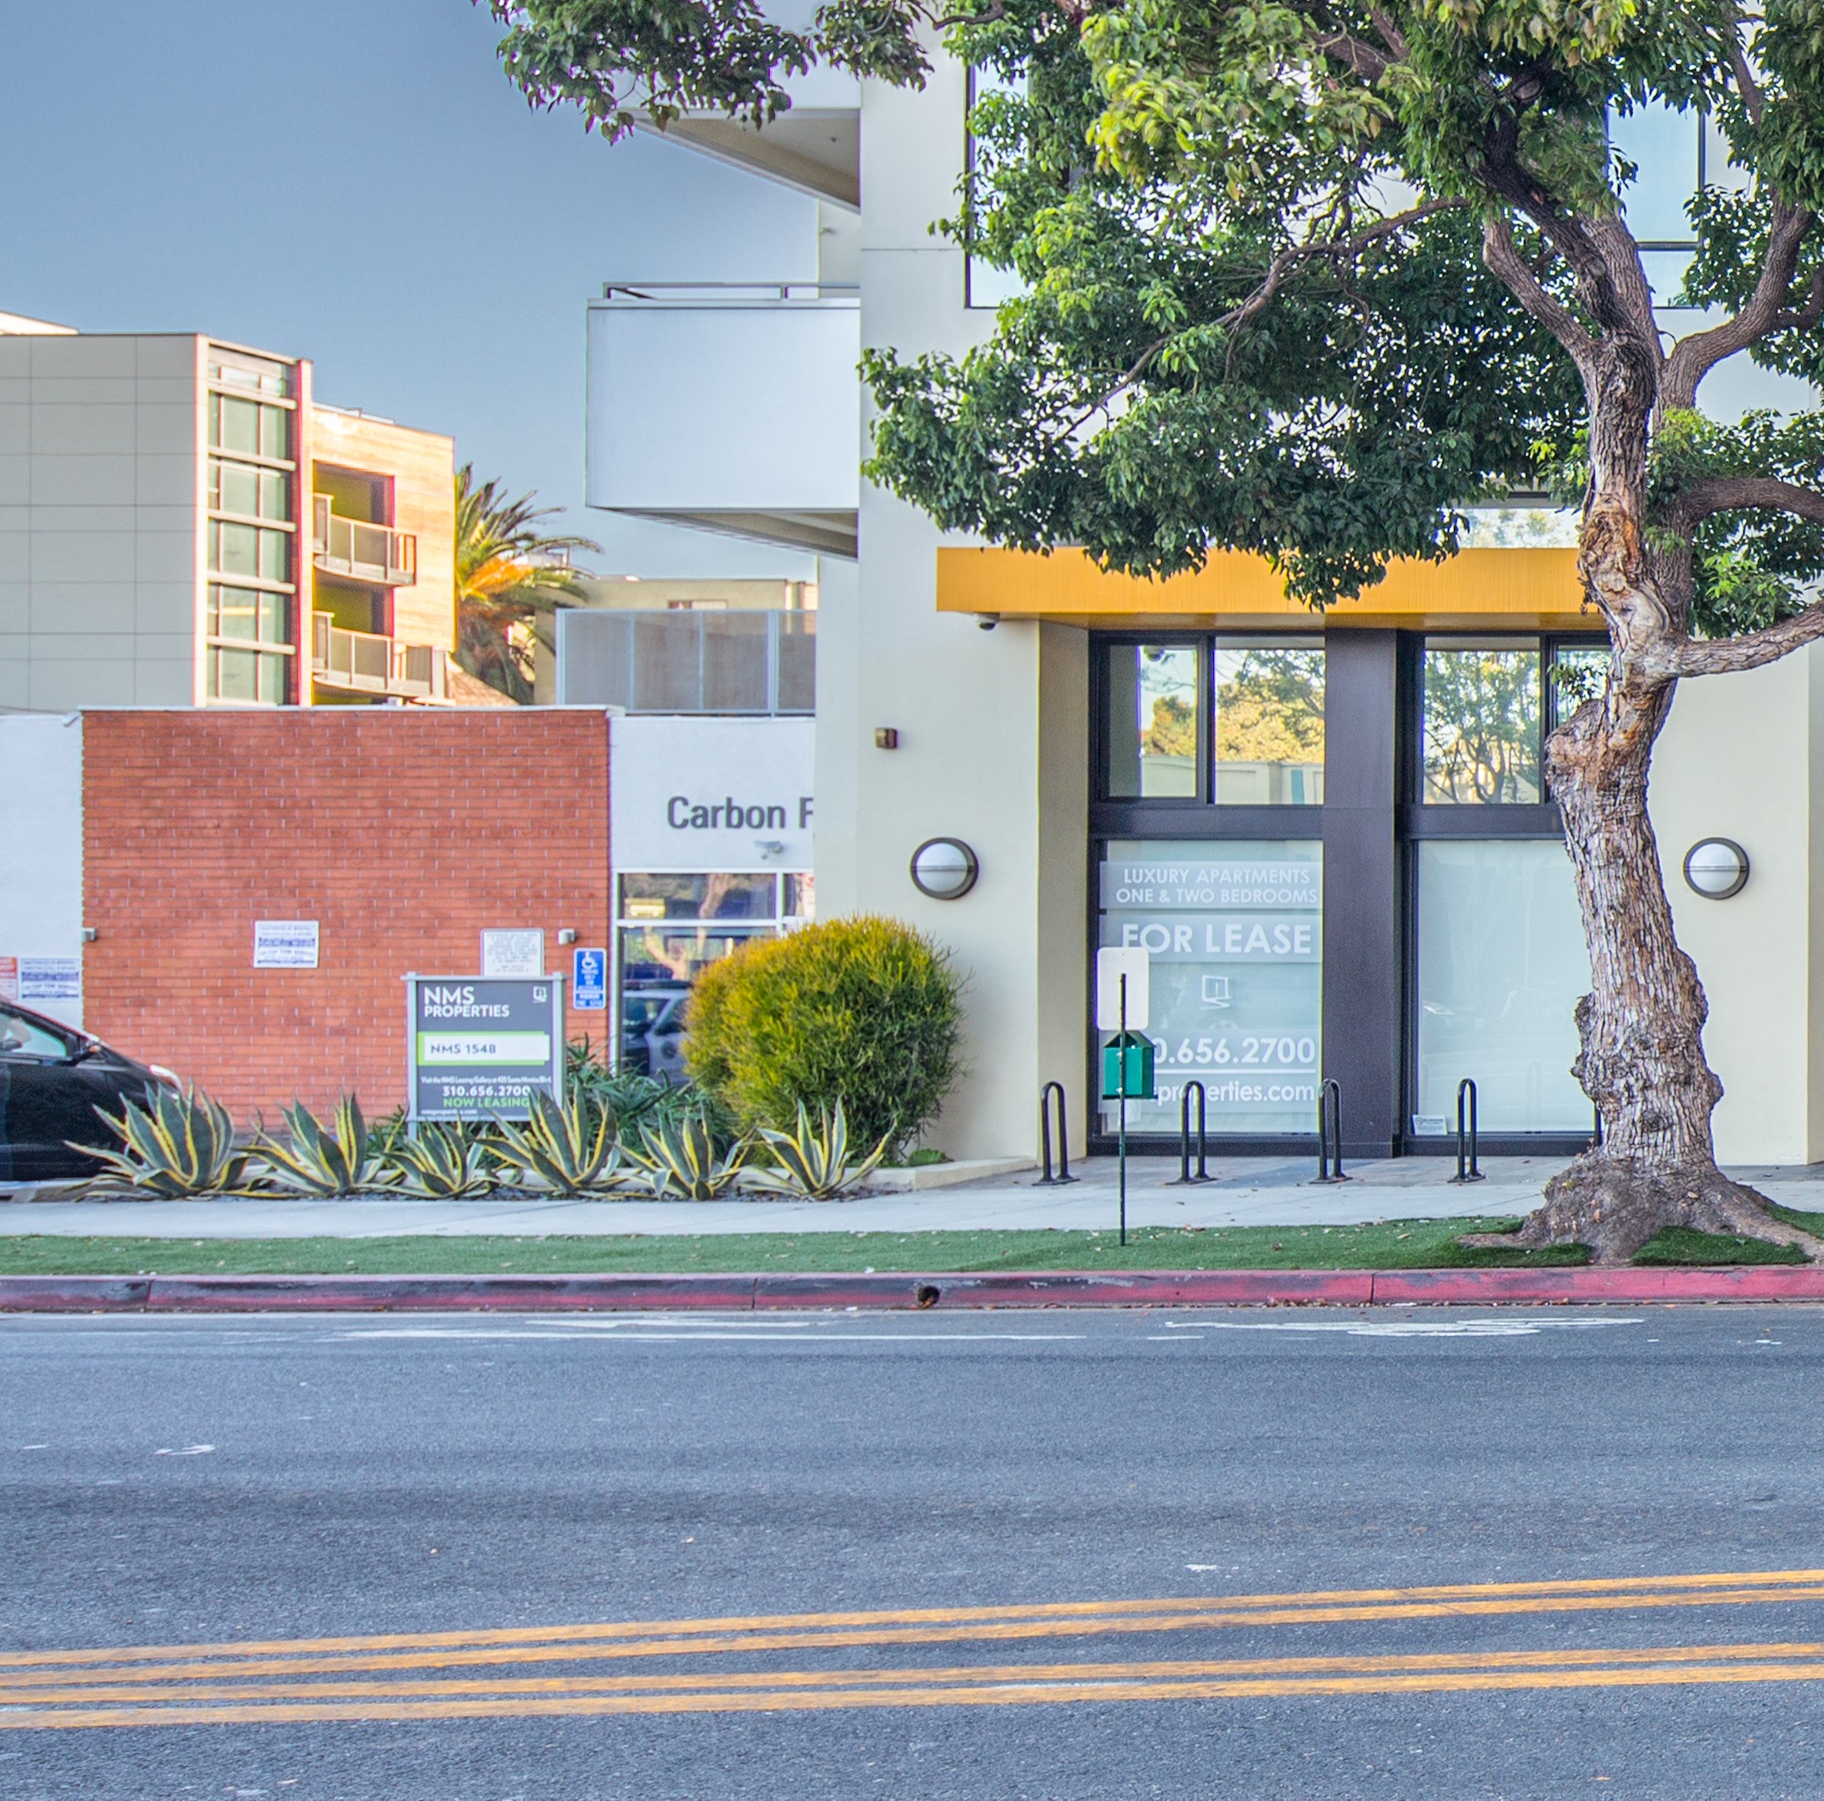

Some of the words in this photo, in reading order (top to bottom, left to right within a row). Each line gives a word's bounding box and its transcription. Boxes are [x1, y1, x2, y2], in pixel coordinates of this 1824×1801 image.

[667, 796, 786, 829] Carbon
[1124, 869, 1189, 884] LUXURY
[1196, 868, 1310, 884] APARTMENTS
[1116, 889, 1153, 903] ONE
[1159, 889, 1170, 903] &
[1176, 889, 1215, 903] TWO
[1221, 888, 1318, 903] BEDROOMS
[1122, 924, 1193, 954] FOR
[1206, 924, 1312, 954] LEASE
[424, 986, 475, 1005] NMS
[424, 1005, 510, 1017] PROPERTIES
[430, 1044, 461, 1054] NMS
[466, 1044, 496, 1054] 1548
[1153, 1037, 1316, 1064] 0.656.2700
[443, 1086, 531, 1097] 310.656.2700
[443, 1098, 475, 1108] NOW
[477, 1098, 529, 1108] LEASING
